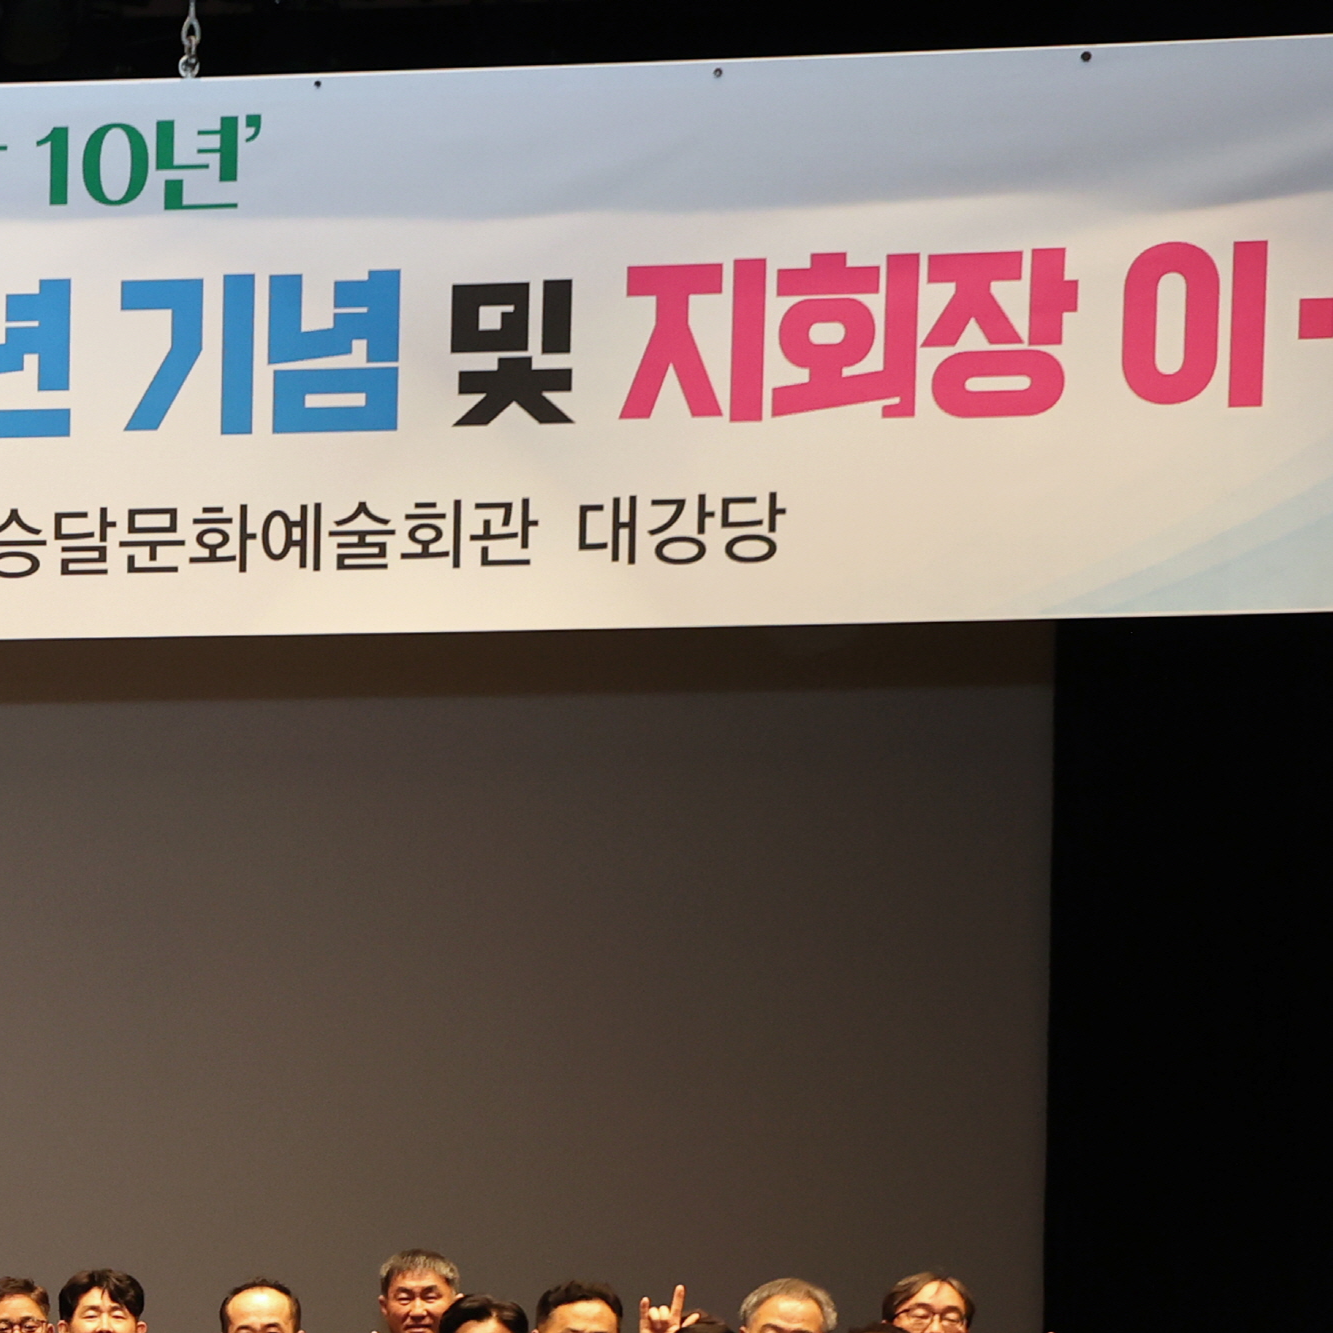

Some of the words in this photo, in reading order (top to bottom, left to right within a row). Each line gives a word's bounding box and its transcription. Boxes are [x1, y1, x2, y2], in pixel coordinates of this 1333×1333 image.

[123, 271, 400, 434] 기념
[451, 279, 573, 426] 및
[621, 248, 1078, 422] 지회장
[579, 492, 786, 564] 대강당
